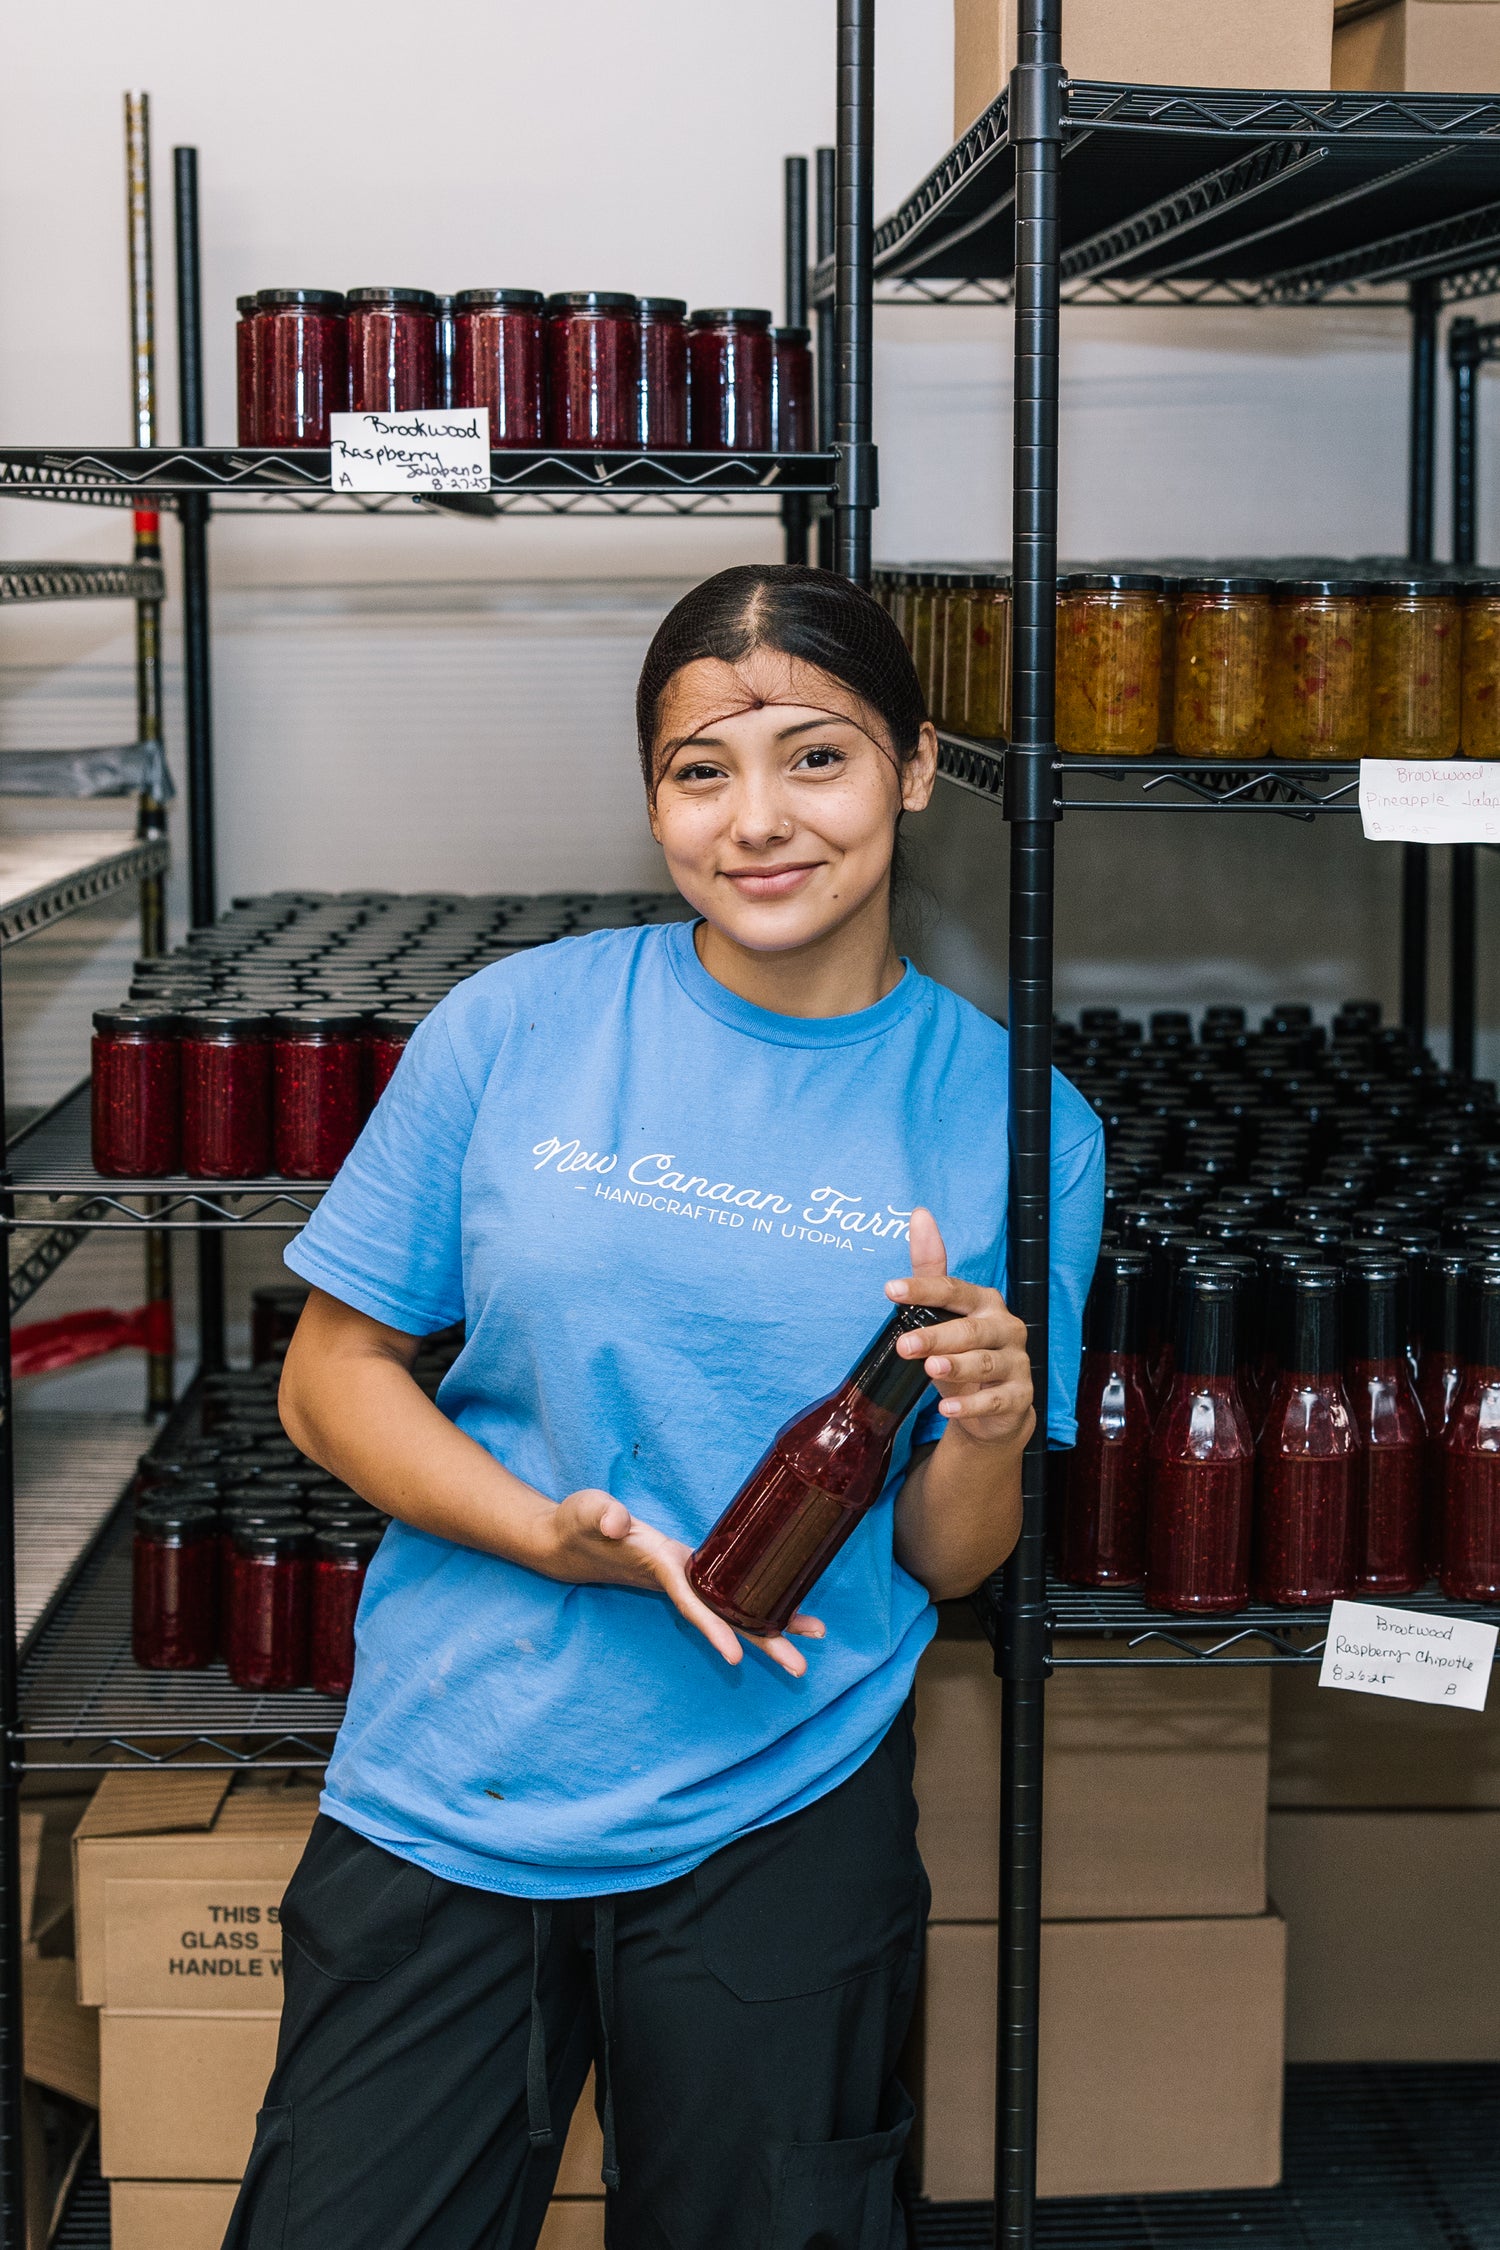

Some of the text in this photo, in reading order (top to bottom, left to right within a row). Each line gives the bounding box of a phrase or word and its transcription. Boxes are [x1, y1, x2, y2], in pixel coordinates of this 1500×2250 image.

[363, 415, 481, 439] Brookwood
[331, 440, 444, 471] Raspberry
[339, 472, 353, 487] A
[1396, 765, 1483, 783] Brookwood
[1366, 792, 1450, 810] Pineapple
[532, 1136, 912, 1242] New Canaan Farm
[594, 1183, 854, 1252] HANDCRAFTED IN UTOPIA
[1376, 1615, 1454, 1641] Brookwood
[1415, 1650, 1474, 1672] Chipotle
[1444, 1683, 1457, 1696] B
[208, 1905, 261, 1924] THIS
[181, 1931, 260, 1950] GLASS
[169, 1957, 264, 1977] HANDLE
